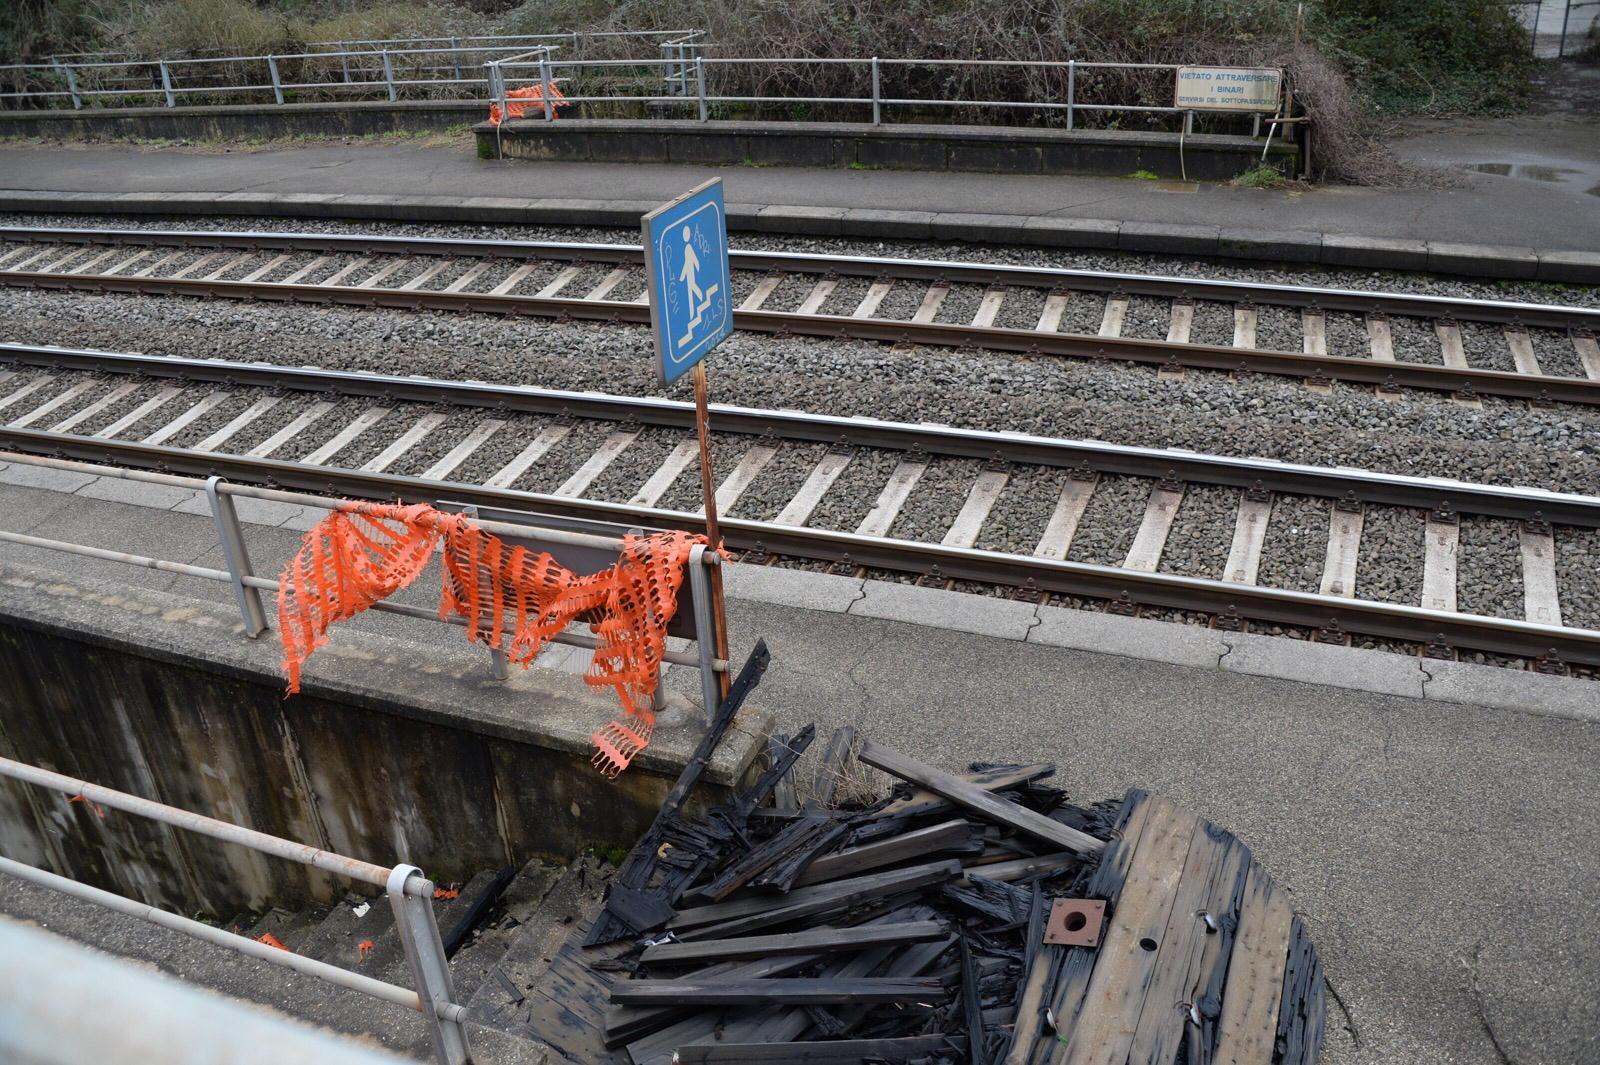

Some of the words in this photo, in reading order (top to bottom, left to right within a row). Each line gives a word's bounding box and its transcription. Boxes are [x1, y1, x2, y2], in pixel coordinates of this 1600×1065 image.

[1179, 72, 1211, 80] VIETATO
[1215, 73, 1278, 82] ATTRAVERSARE
[1217, 86, 1244, 94] BINARI
